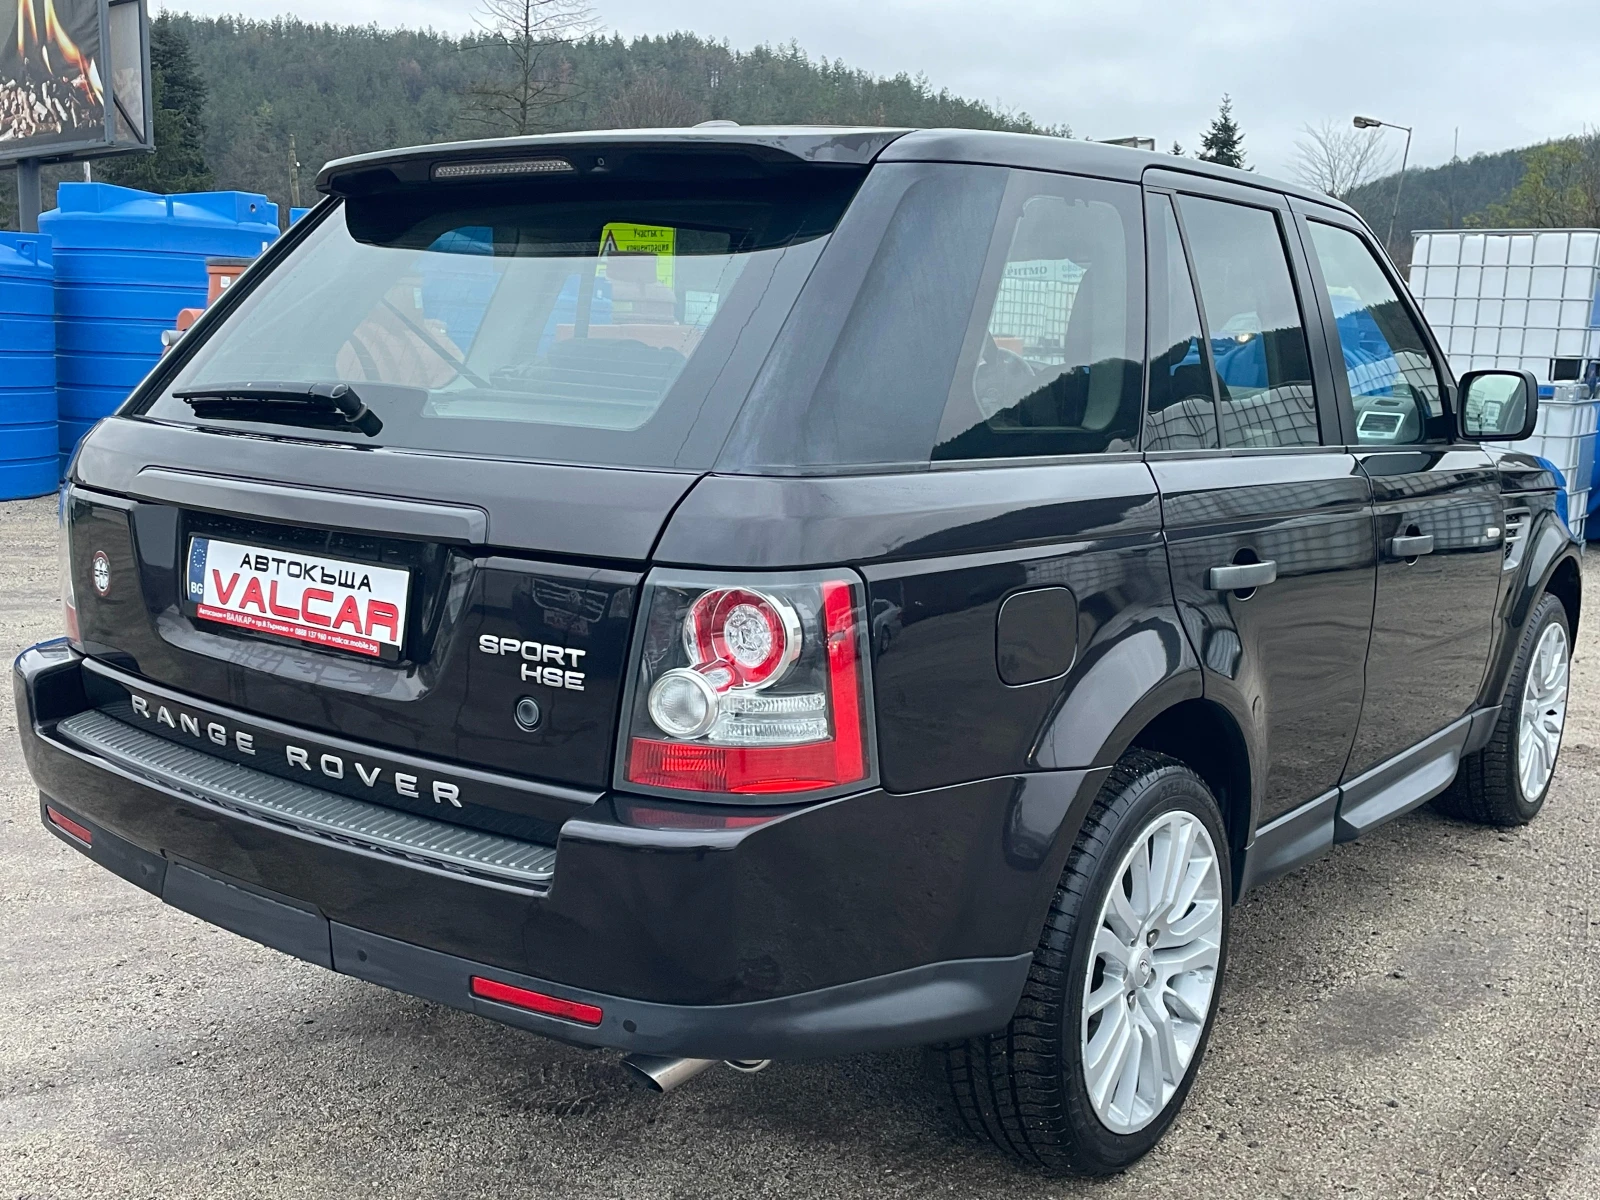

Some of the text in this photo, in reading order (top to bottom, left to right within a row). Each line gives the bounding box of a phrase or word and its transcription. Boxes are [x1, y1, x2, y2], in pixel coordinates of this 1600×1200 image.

[190, 581, 204, 595] BG
[240, 552, 372, 592] АВТОКЪЩА
[212, 568, 399, 641] VALCAR
[226, 613, 252, 625] ВАЛКАР
[332, 636, 378, 653] valcar.mobile.bg
[479, 634, 586, 667] SPORT
[520, 663, 585, 691] HSE
[131, 694, 462, 807] RANGE ROVER
